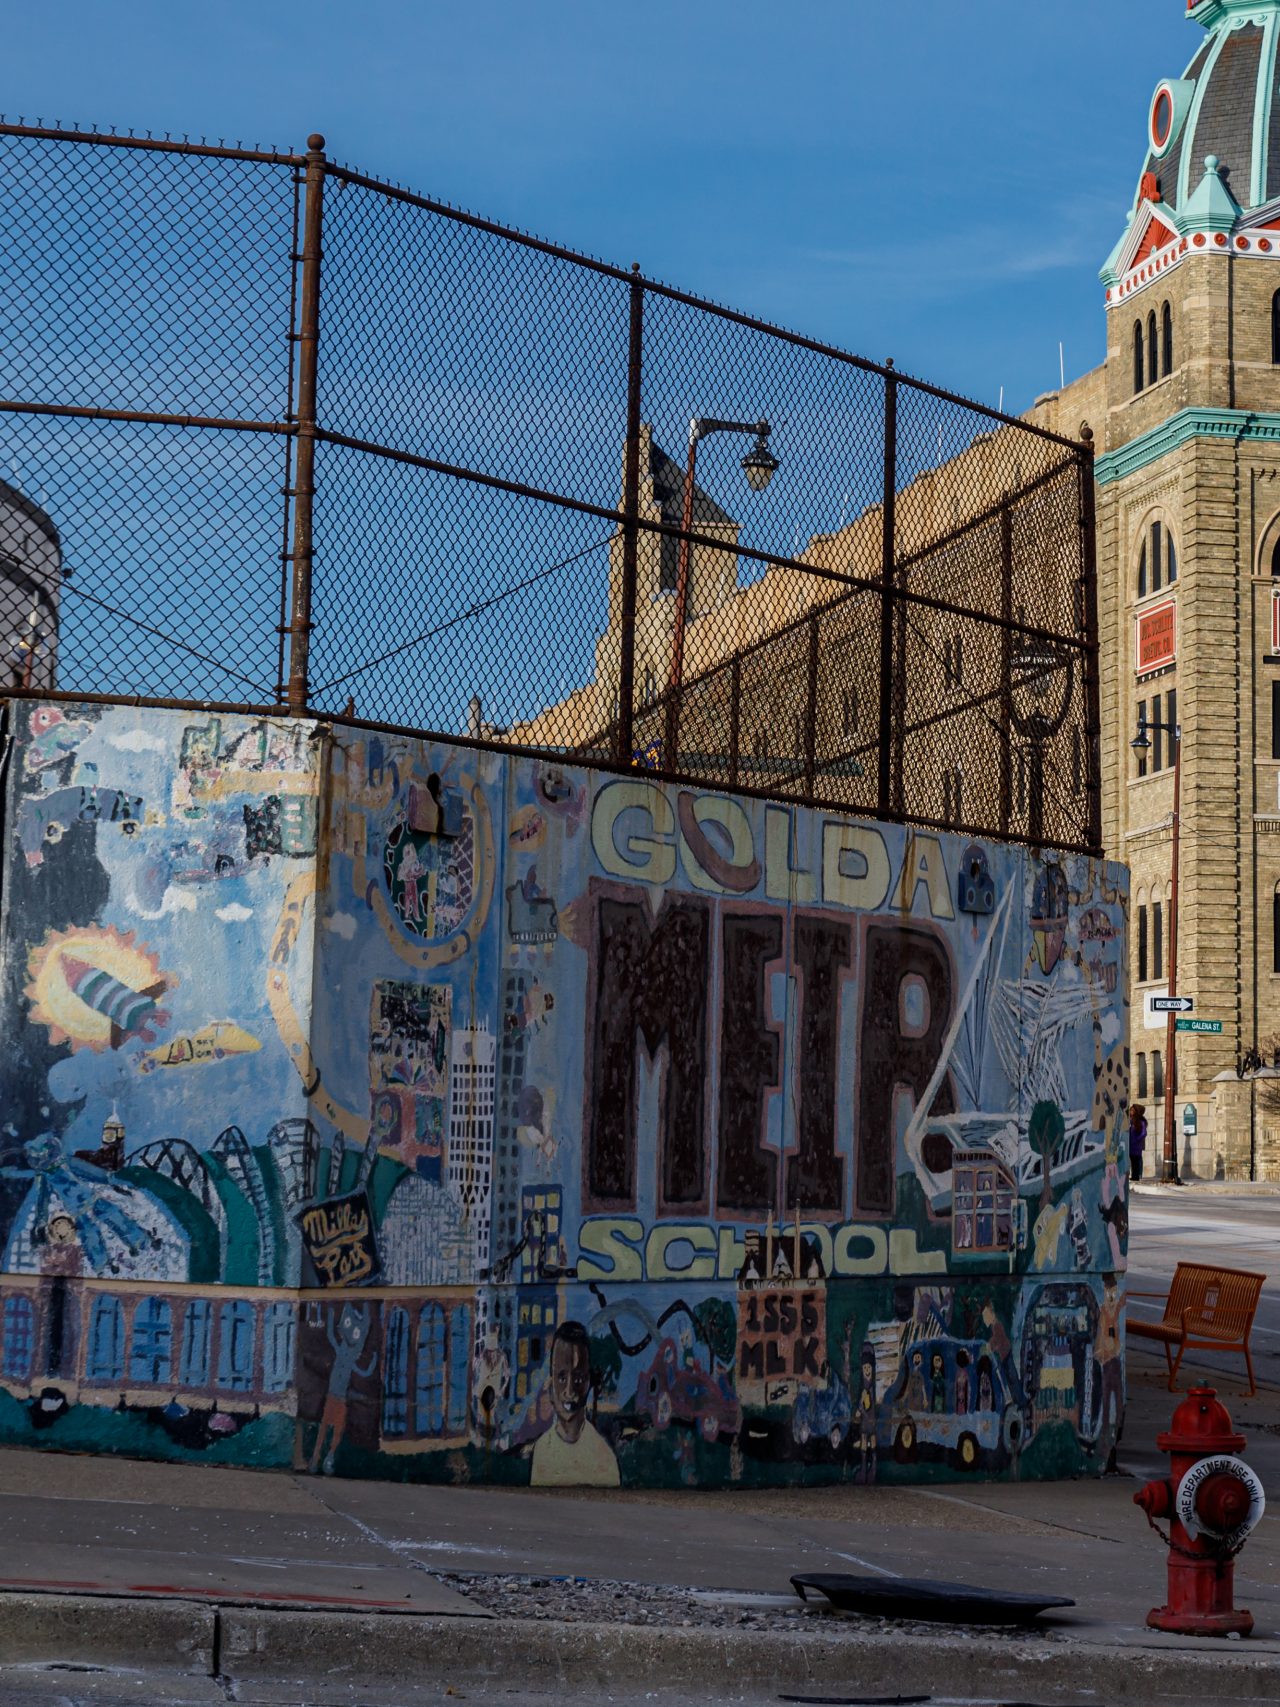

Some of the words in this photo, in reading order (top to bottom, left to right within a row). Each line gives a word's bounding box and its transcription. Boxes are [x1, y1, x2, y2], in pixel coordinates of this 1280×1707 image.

[590, 779, 956, 921] GOLDA
[1191, 1021, 1212, 1030] GALENA
[582, 876, 960, 1222] MEIR
[1182, 1460, 1231, 1498] DEPARTMENT
[1231, 1463, 1248, 1481] USE
[1245, 1480, 1260, 1503] ONLY
[1182, 1499, 1193, 1522] FIRE
